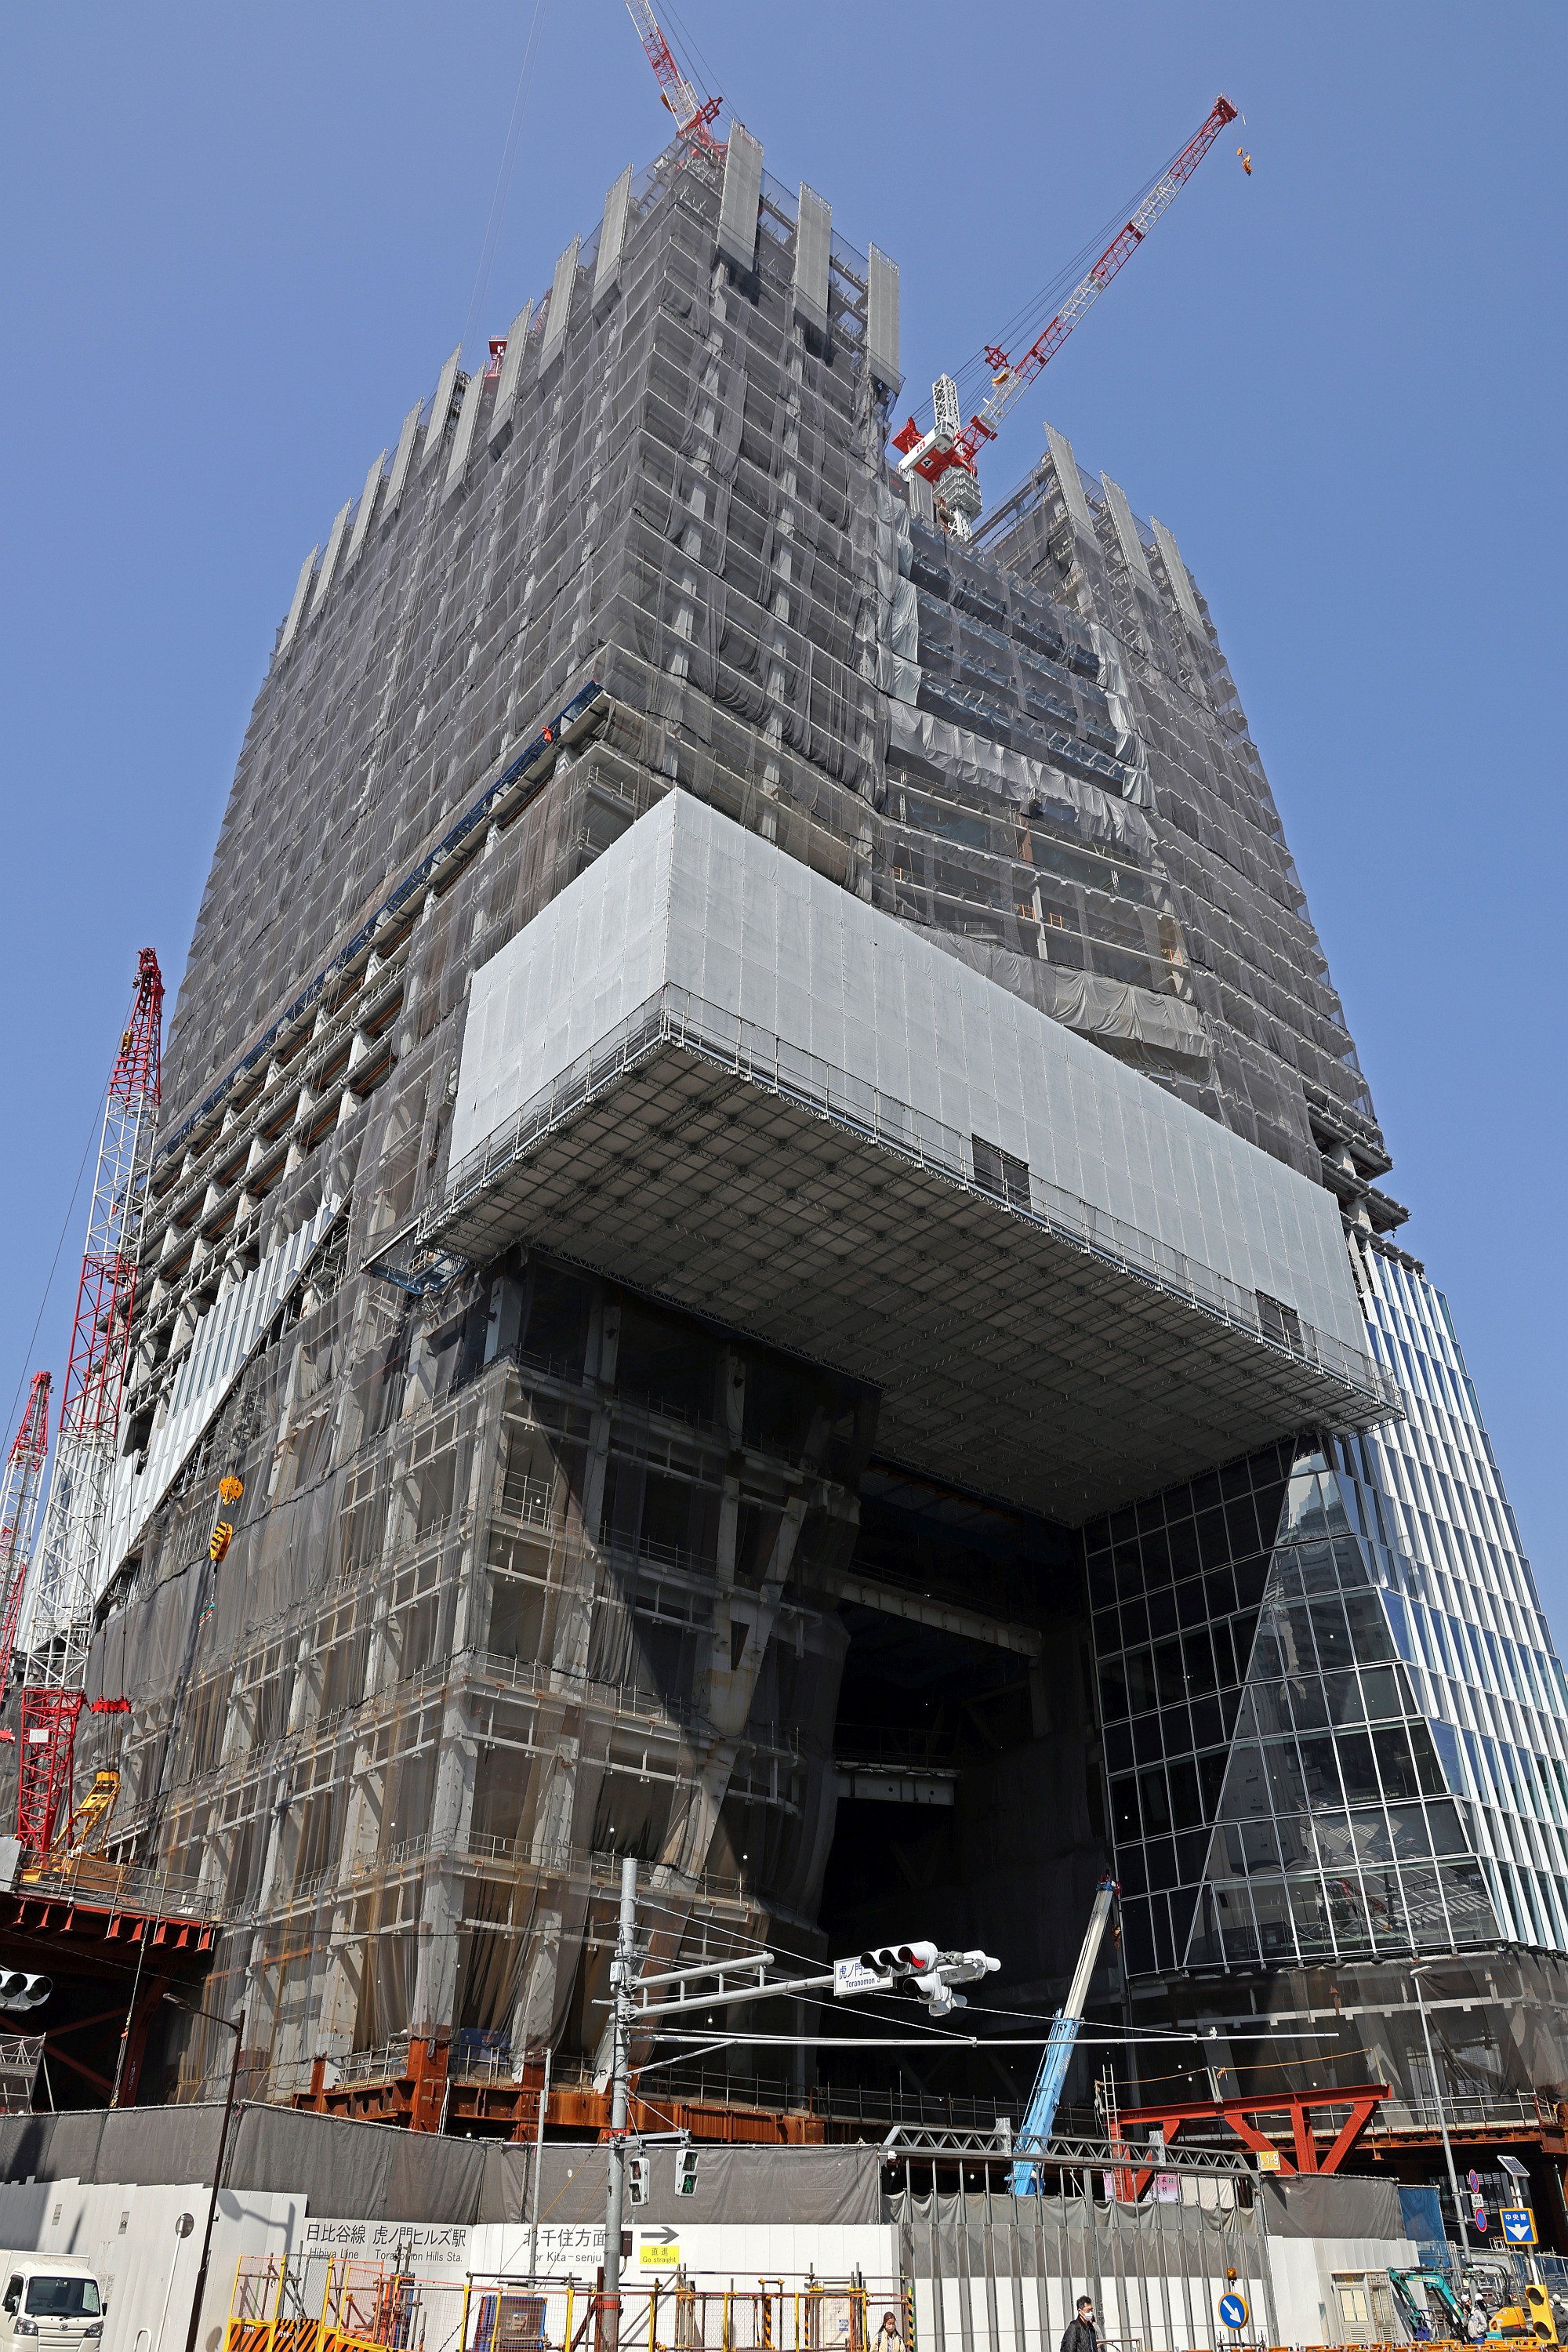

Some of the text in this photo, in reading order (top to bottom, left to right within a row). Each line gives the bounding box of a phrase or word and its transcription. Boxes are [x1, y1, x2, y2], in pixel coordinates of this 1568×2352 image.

[839, 1963, 876, 1980] 虎ノ門
[845, 1977, 875, 1988] Toranomon
[307, 2223, 466, 2248] 日比谷線 虎ノ門ヒルズ駅
[523, 2228, 606, 2247] 北千住方面
[340, 2248, 359, 2259] Line
[375, 2249, 463, 2263] Toraoon Hills Sta.
[529, 2251, 601, 2264] or Kita-senju
[652, 2247, 669, 2256] 直進
[653, 2256, 677, 2264] straight
